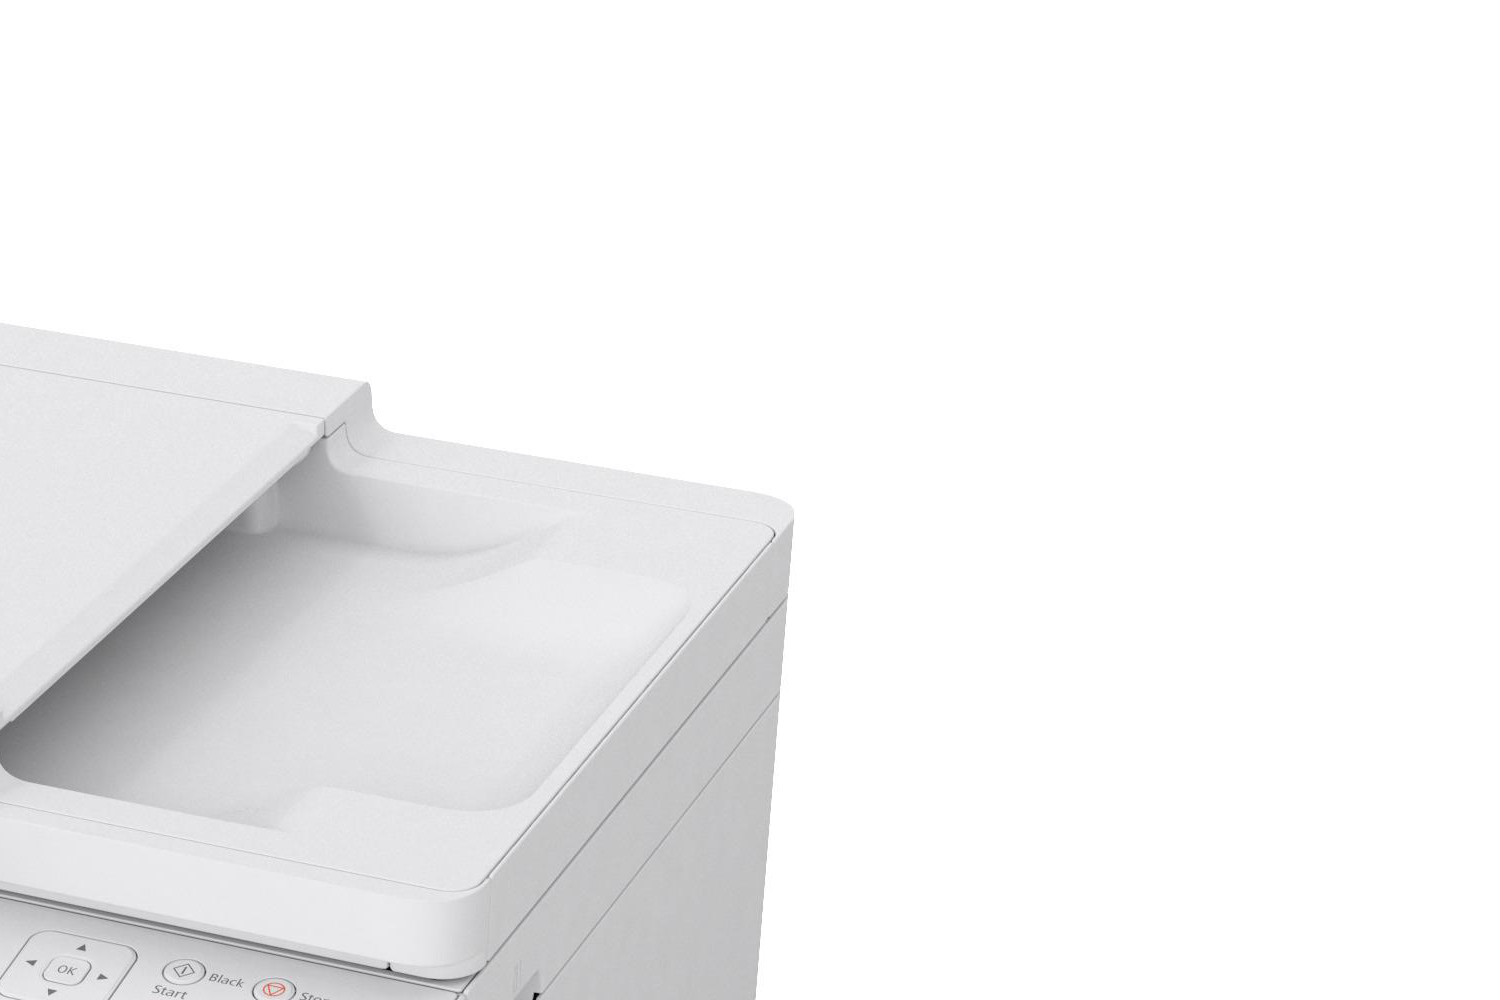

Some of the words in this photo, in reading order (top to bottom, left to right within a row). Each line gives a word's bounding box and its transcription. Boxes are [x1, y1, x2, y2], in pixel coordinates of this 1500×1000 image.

[57, 964, 78, 977] OK
[208, 972, 245, 989] Black
[151, 984, 188, 1000] Start
